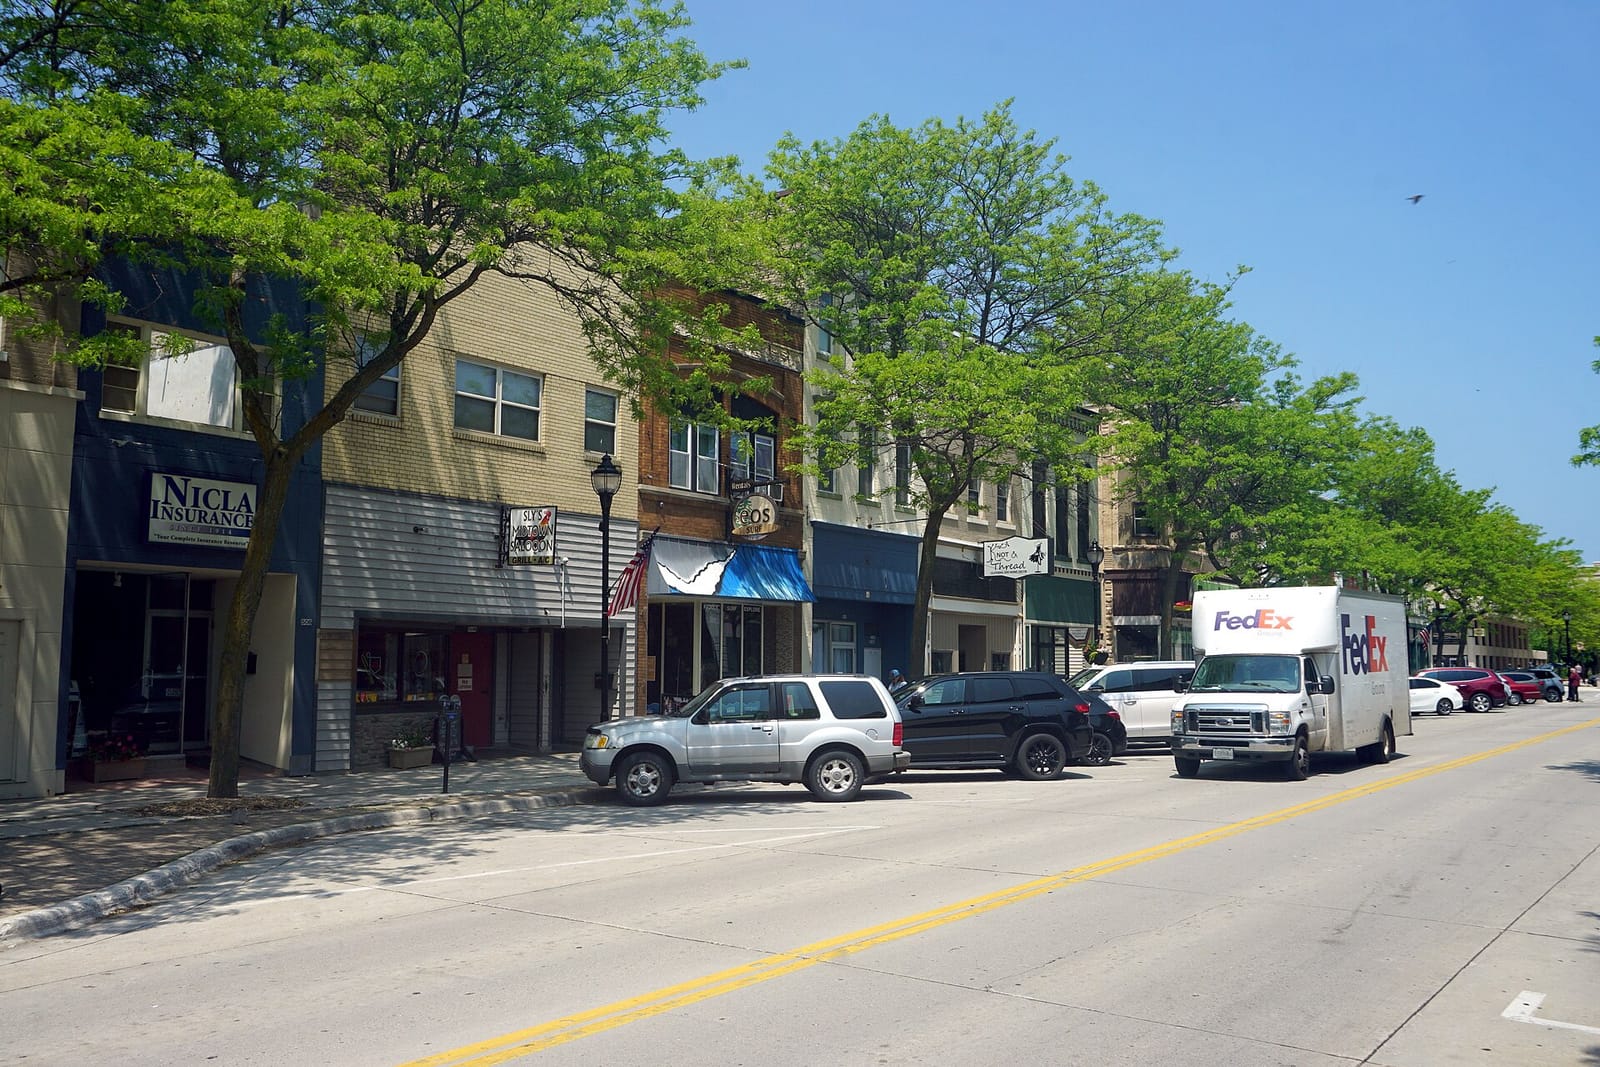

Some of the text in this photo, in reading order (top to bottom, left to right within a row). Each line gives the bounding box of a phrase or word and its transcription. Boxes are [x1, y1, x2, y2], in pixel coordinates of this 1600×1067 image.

[523, 510, 543, 522] SLY'S
[512, 524, 554, 538] MIDTOWN
[745, 524, 763, 534] SURF
[512, 556, 532, 564] GRILL
[991, 561, 1026, 571] Thread
[1214, 609, 1295, 631] FedEx
[1341, 614, 1389, 675] FedEx
